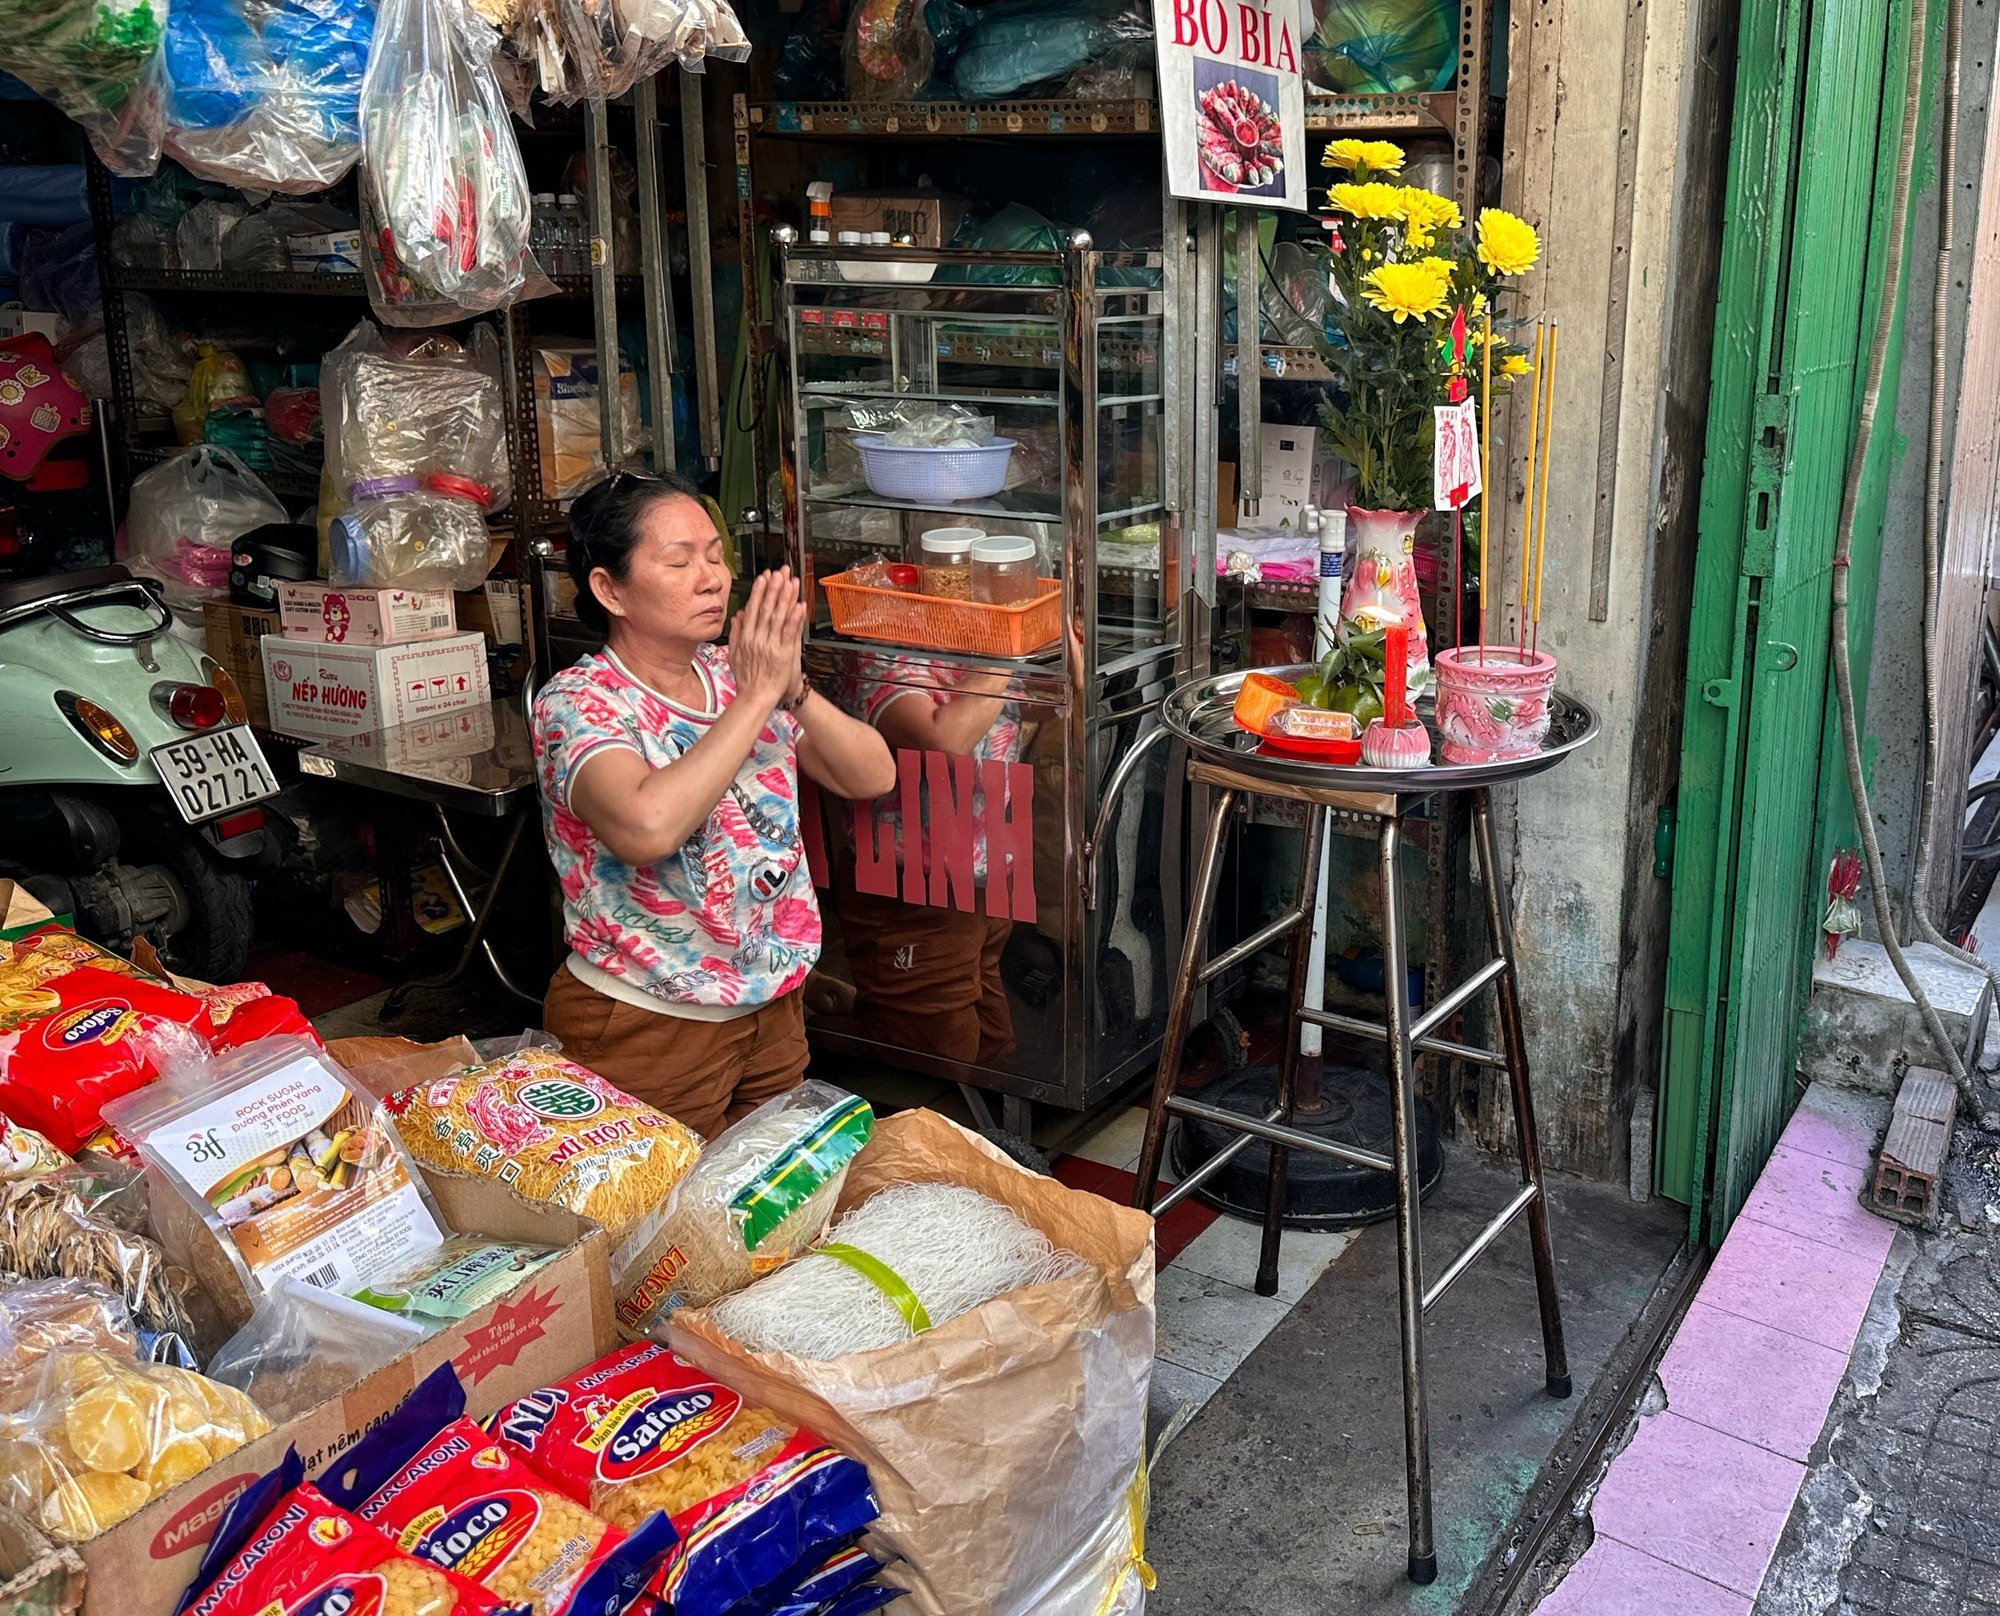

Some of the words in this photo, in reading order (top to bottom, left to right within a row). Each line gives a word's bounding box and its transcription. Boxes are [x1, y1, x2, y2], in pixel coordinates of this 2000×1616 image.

[1237, 0, 1298, 74] BÍA
[292, 676, 318, 703] NẾP
[322, 681, 367, 710] HƯƠNG
[167, 732, 249, 778] 59-HA
[181, 763, 270, 815] 027.21
[64, 1007, 123, 1041] Safoco
[235, 1096, 268, 1118] ROCK
[267, 1080, 305, 1103] SUGAR
[260, 1118, 275, 1130] 3T
[277, 1103, 306, 1122] FOOD
[549, 1134, 582, 1168] MÌ
[586, 1119, 638, 1147] HỘT
[637, 1111, 671, 1128] GÀ
[630, 1138, 653, 1155] Eggs
[576, 1172, 597, 1190] 500
[598, 1169, 610, 1182] gr
[643, 1244, 690, 1297] LONG
[488, 1317, 516, 1341] Tặng
[500, 1332, 515, 1346] tinh
[515, 1326, 528, 1338] cao
[577, 1344, 665, 1389] MACARON
[502, 1389, 569, 1452] NUI
[608, 1413, 623, 1432] bảo
[613, 1393, 713, 1462] Safoco
[327, 1434, 361, 1461] nêm
[363, 1436, 470, 1520] MACARONI
[163, 1479, 248, 1550] Maggi
[428, 1502, 508, 1566] foco
[195, 1504, 306, 1616] MACARONI
[560, 1538, 580, 1556] 500
[577, 1534, 586, 1544] g
[581, 1542, 592, 1552] oz
